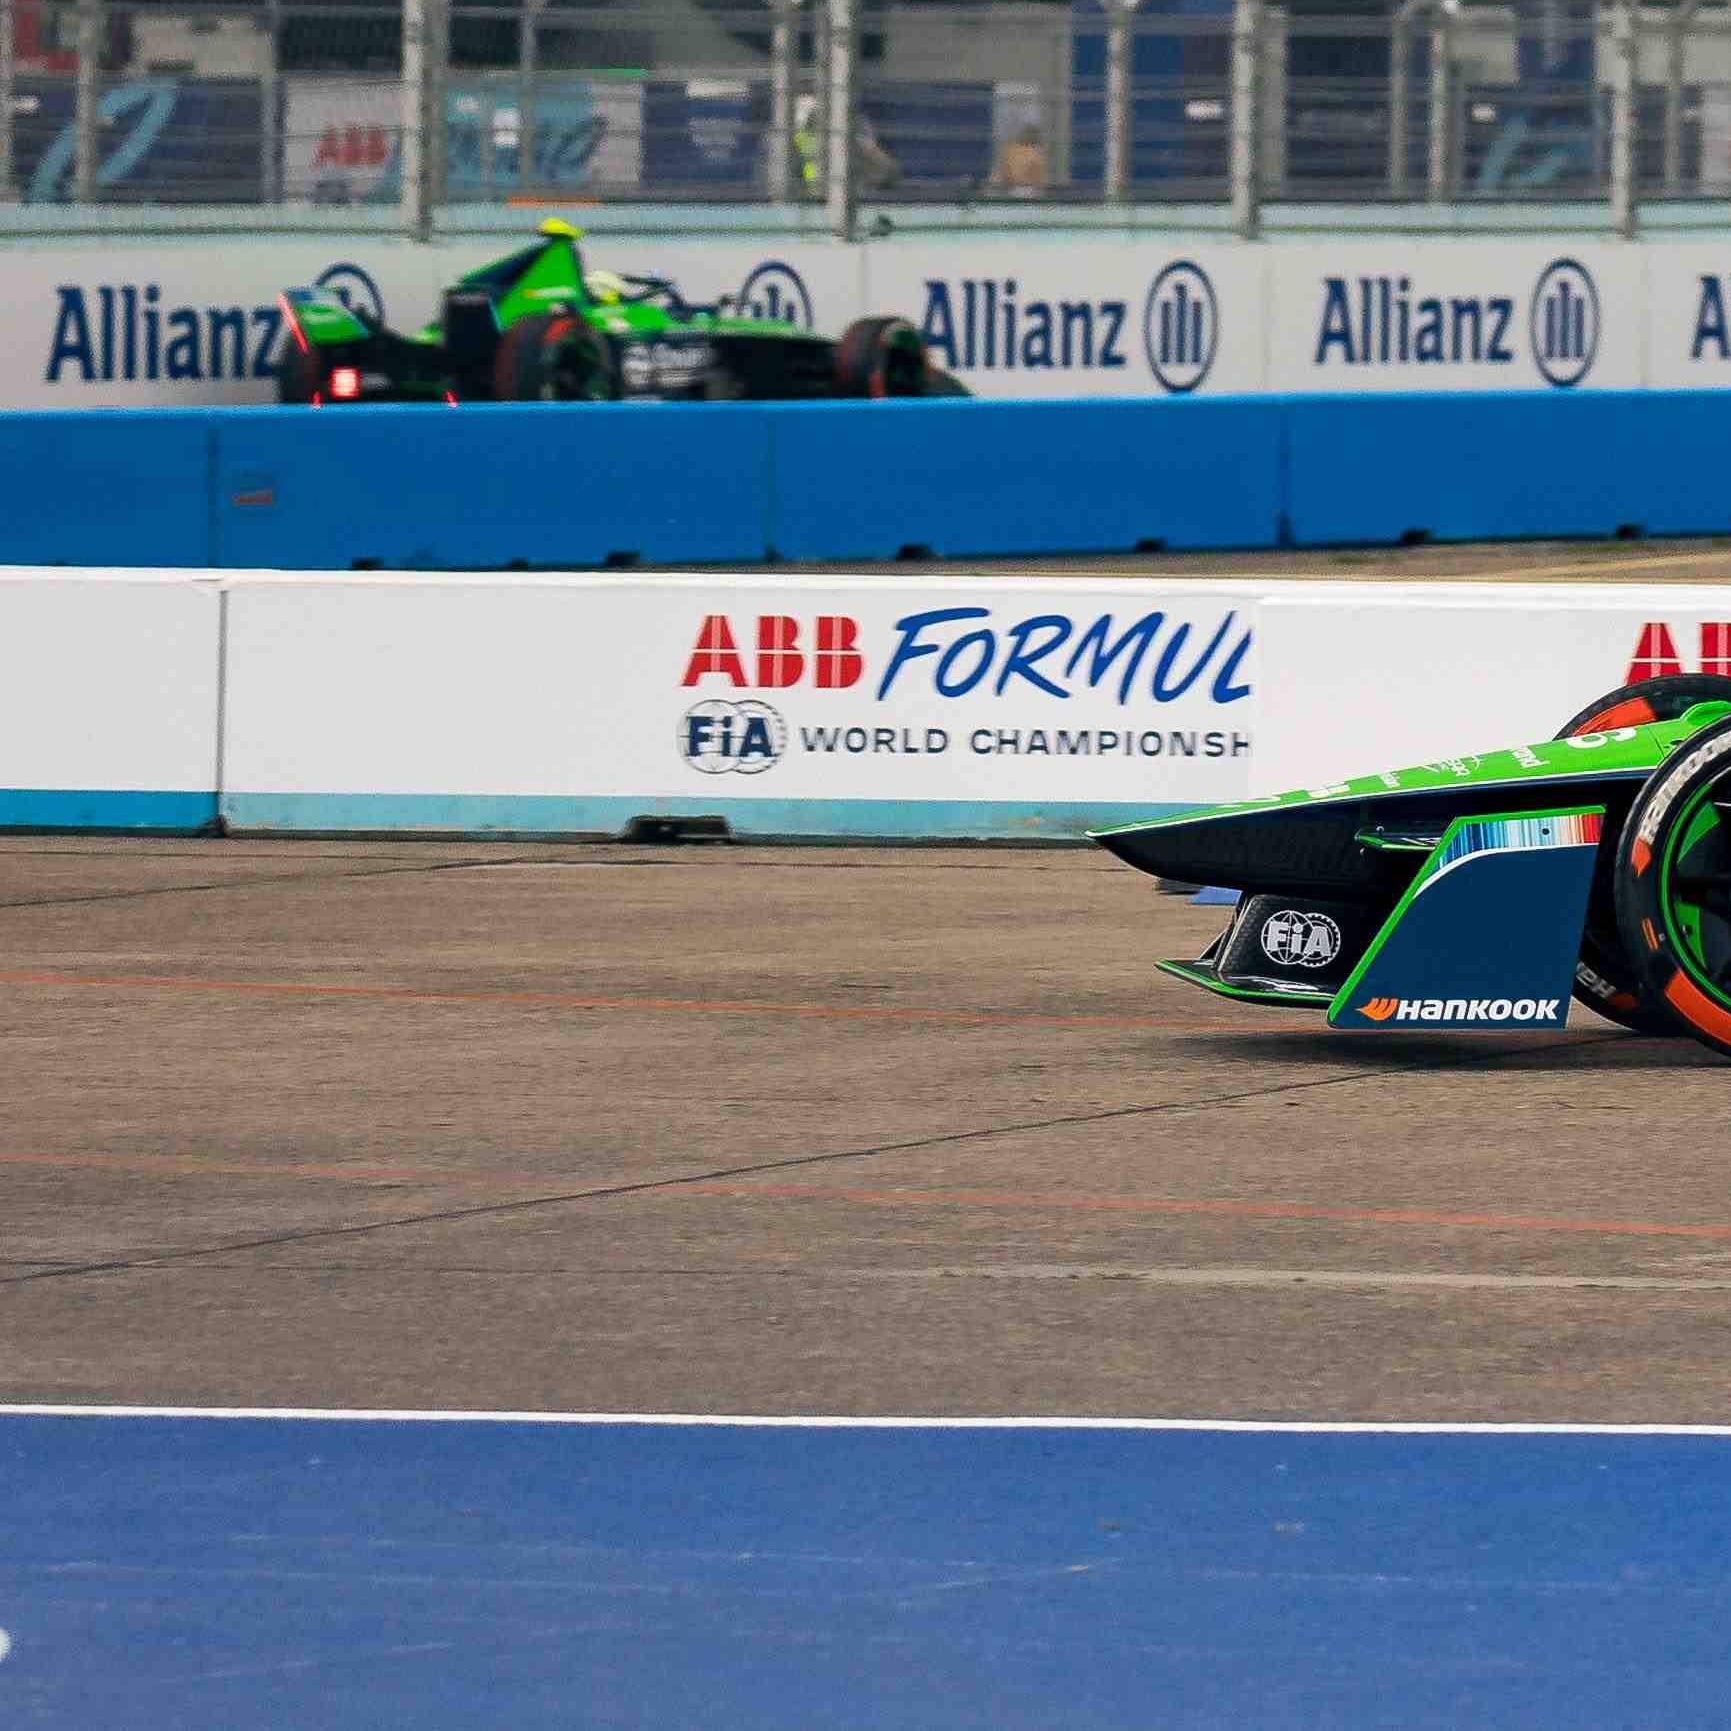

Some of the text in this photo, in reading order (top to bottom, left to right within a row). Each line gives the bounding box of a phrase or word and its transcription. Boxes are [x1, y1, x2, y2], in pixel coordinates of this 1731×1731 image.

[46, 286, 283, 382] Allianz
[919, 278, 1128, 372] Allianz
[1314, 278, 1515, 366] Allianz
[681, 615, 864, 689] ABB
[801, 727, 949, 755] WORLD
